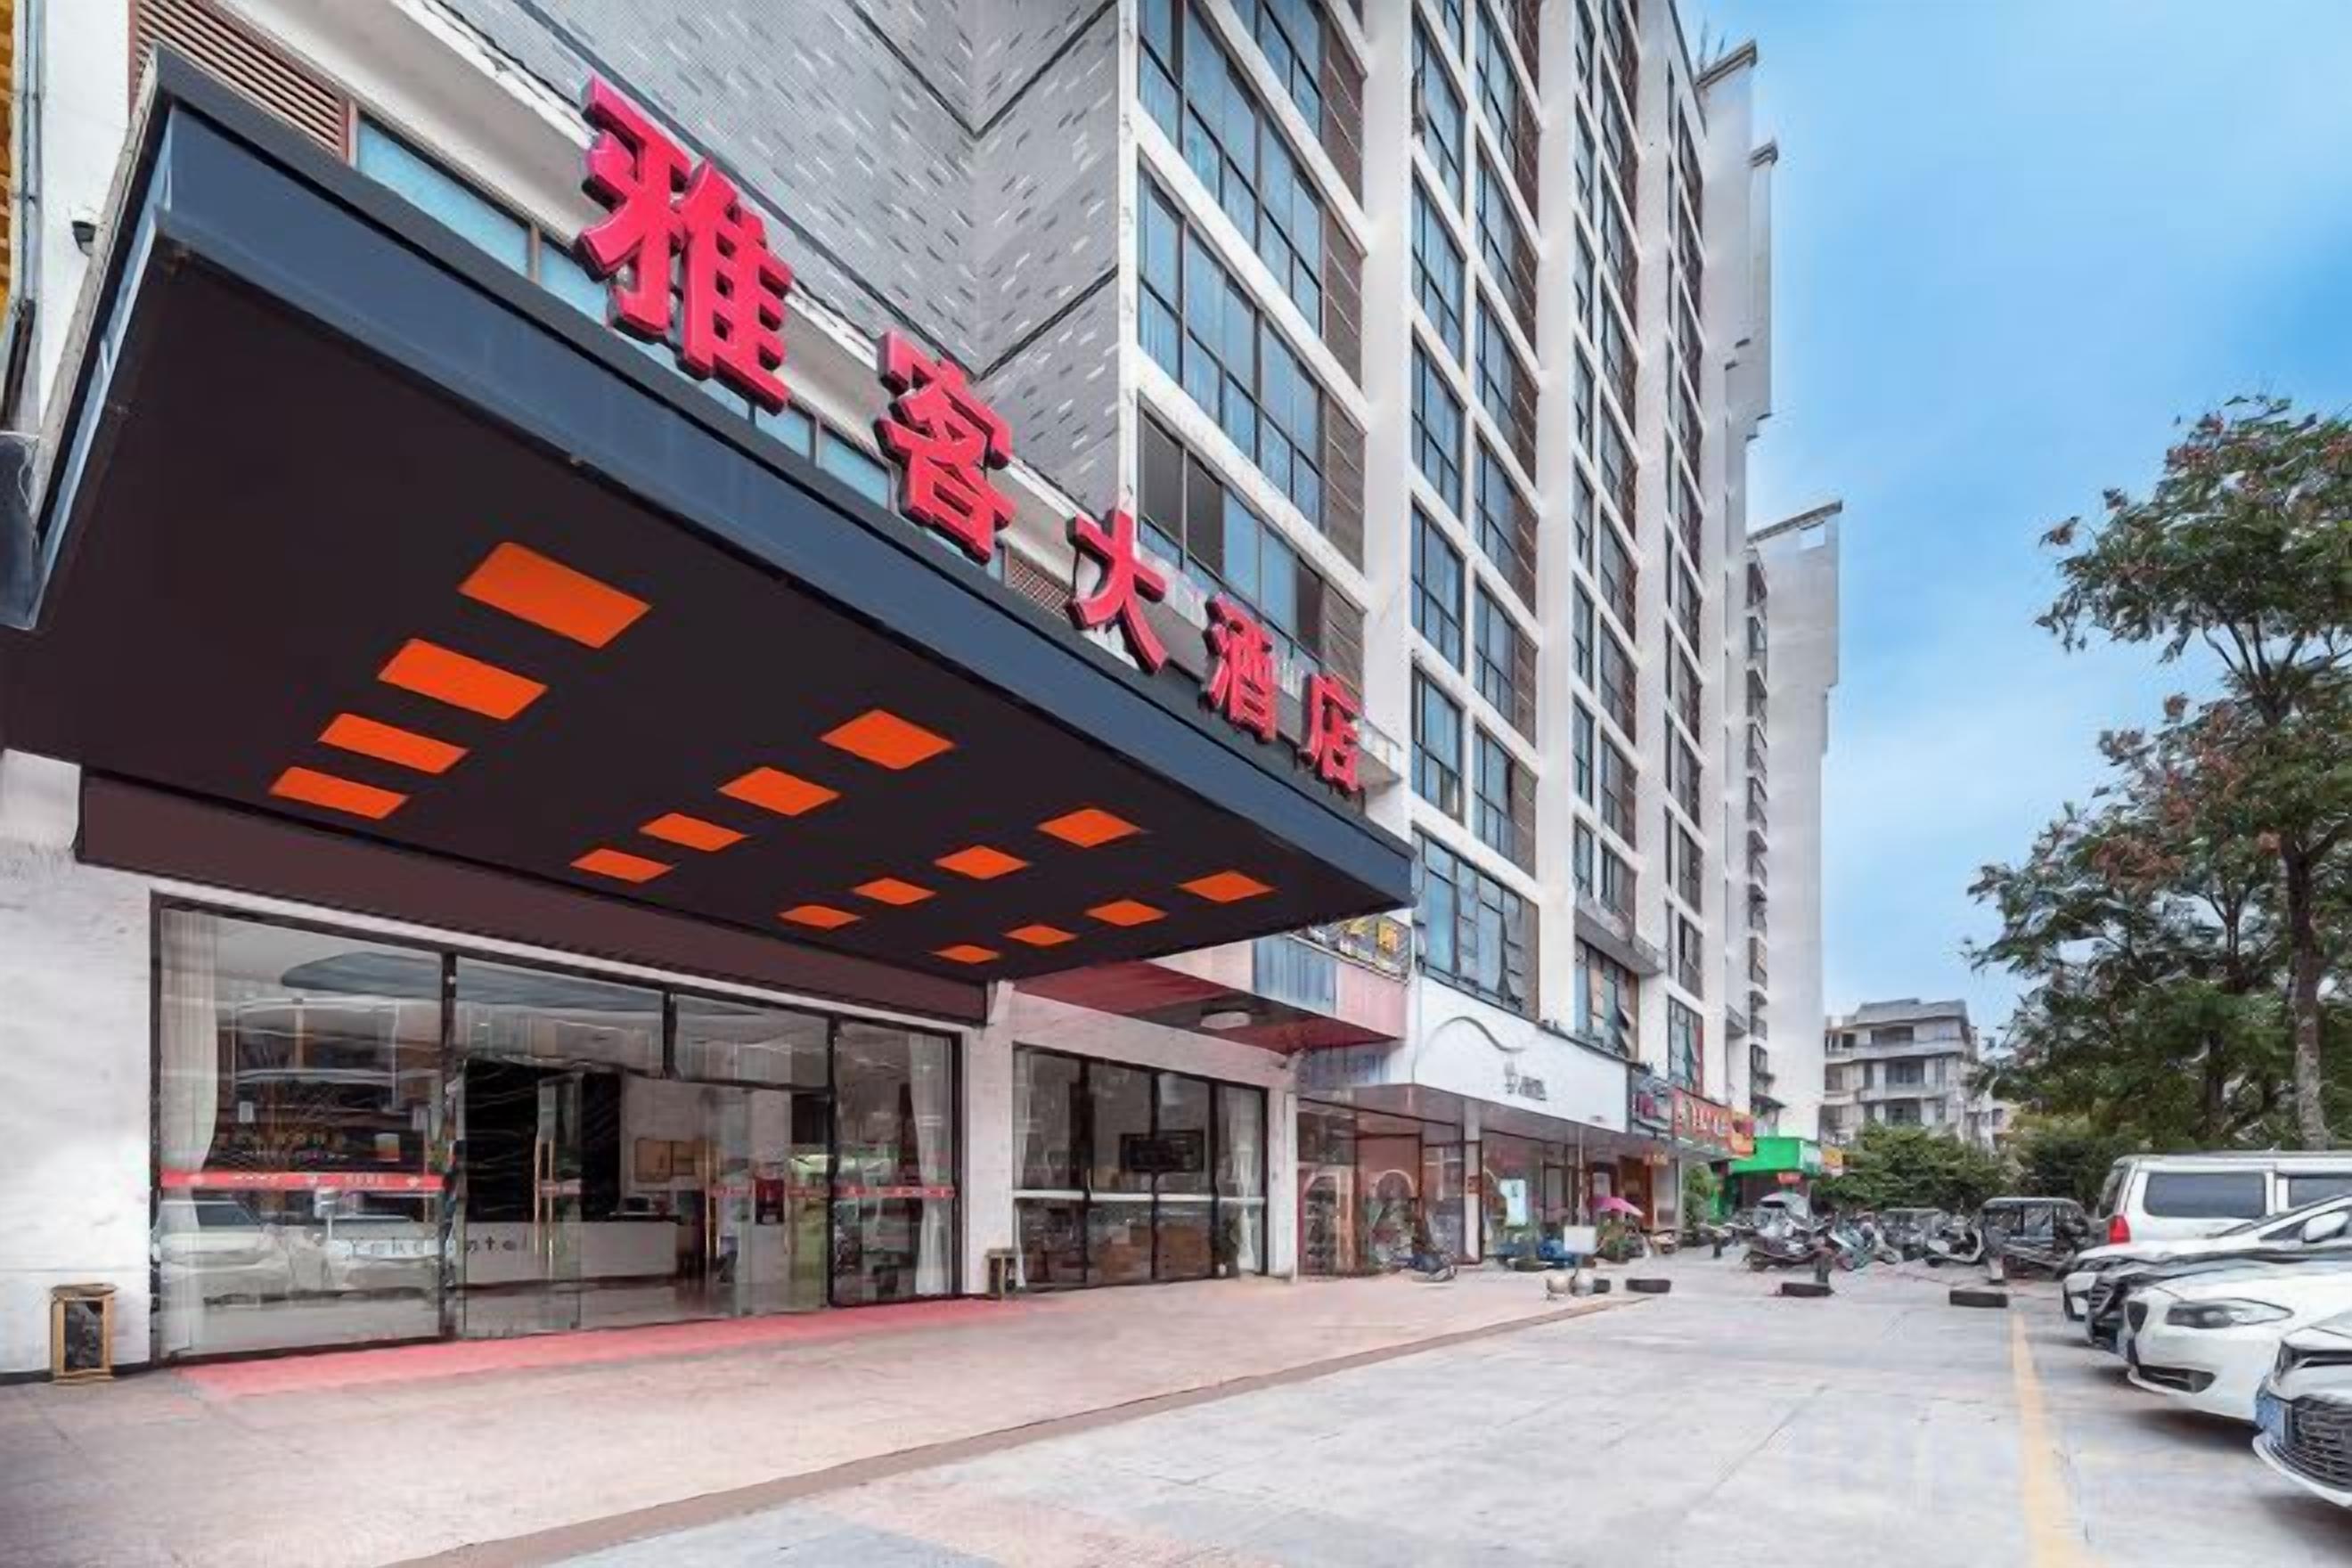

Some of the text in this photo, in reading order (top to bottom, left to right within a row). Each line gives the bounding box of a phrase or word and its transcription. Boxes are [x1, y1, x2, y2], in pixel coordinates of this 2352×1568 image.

[576, 74, 1363, 793] 雅客大酒店
